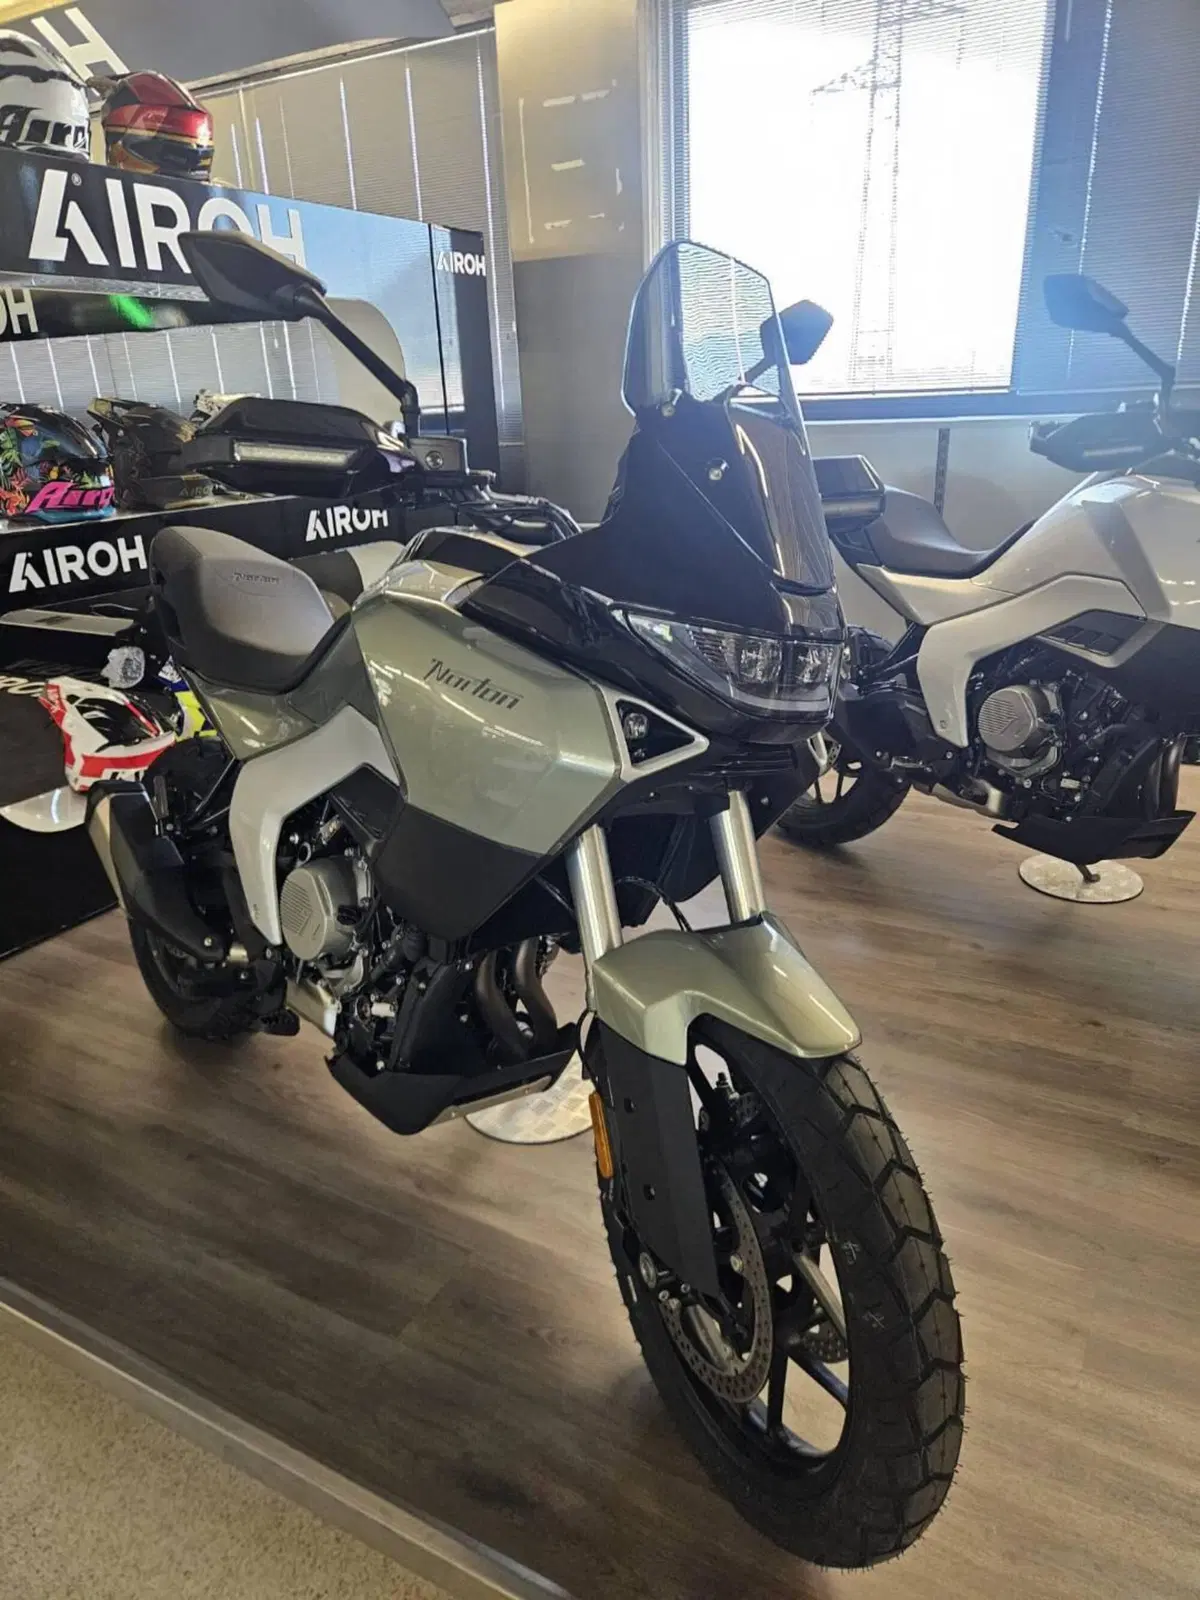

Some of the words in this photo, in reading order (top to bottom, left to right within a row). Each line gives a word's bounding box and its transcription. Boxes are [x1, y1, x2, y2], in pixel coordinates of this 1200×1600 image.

[437, 251, 486, 276] AIROH
[305, 504, 388, 542] AIROH
[8, 534, 148, 593] AIROH
[423, 658, 524, 709] Norton
